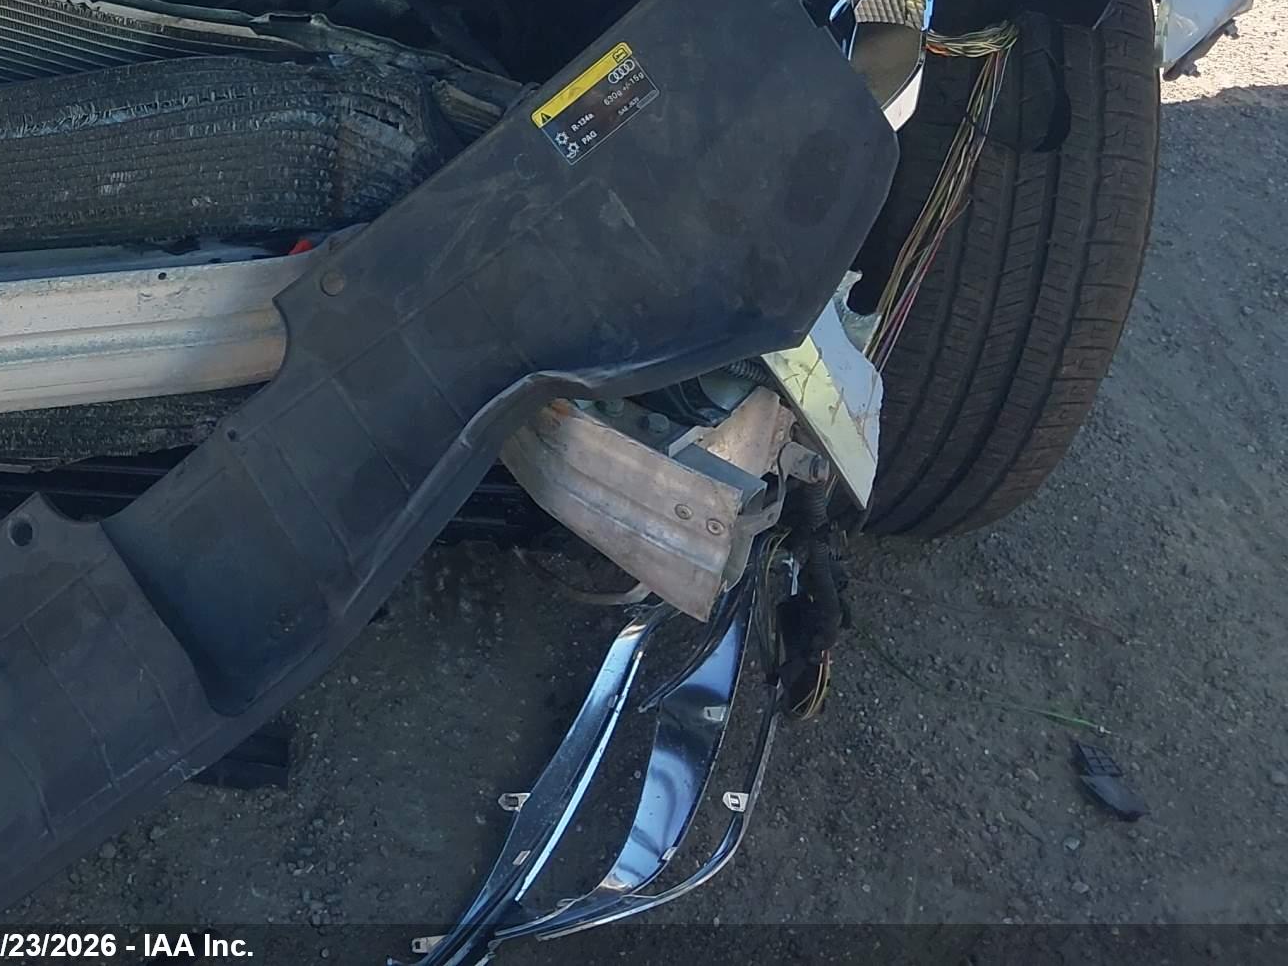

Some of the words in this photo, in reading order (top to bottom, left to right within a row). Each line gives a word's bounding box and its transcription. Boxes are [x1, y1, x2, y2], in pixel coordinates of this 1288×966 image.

[603, 89, 623, 106] 630g
[571, 113, 594, 132] R-134a
[581, 130, 597, 145] PAG
